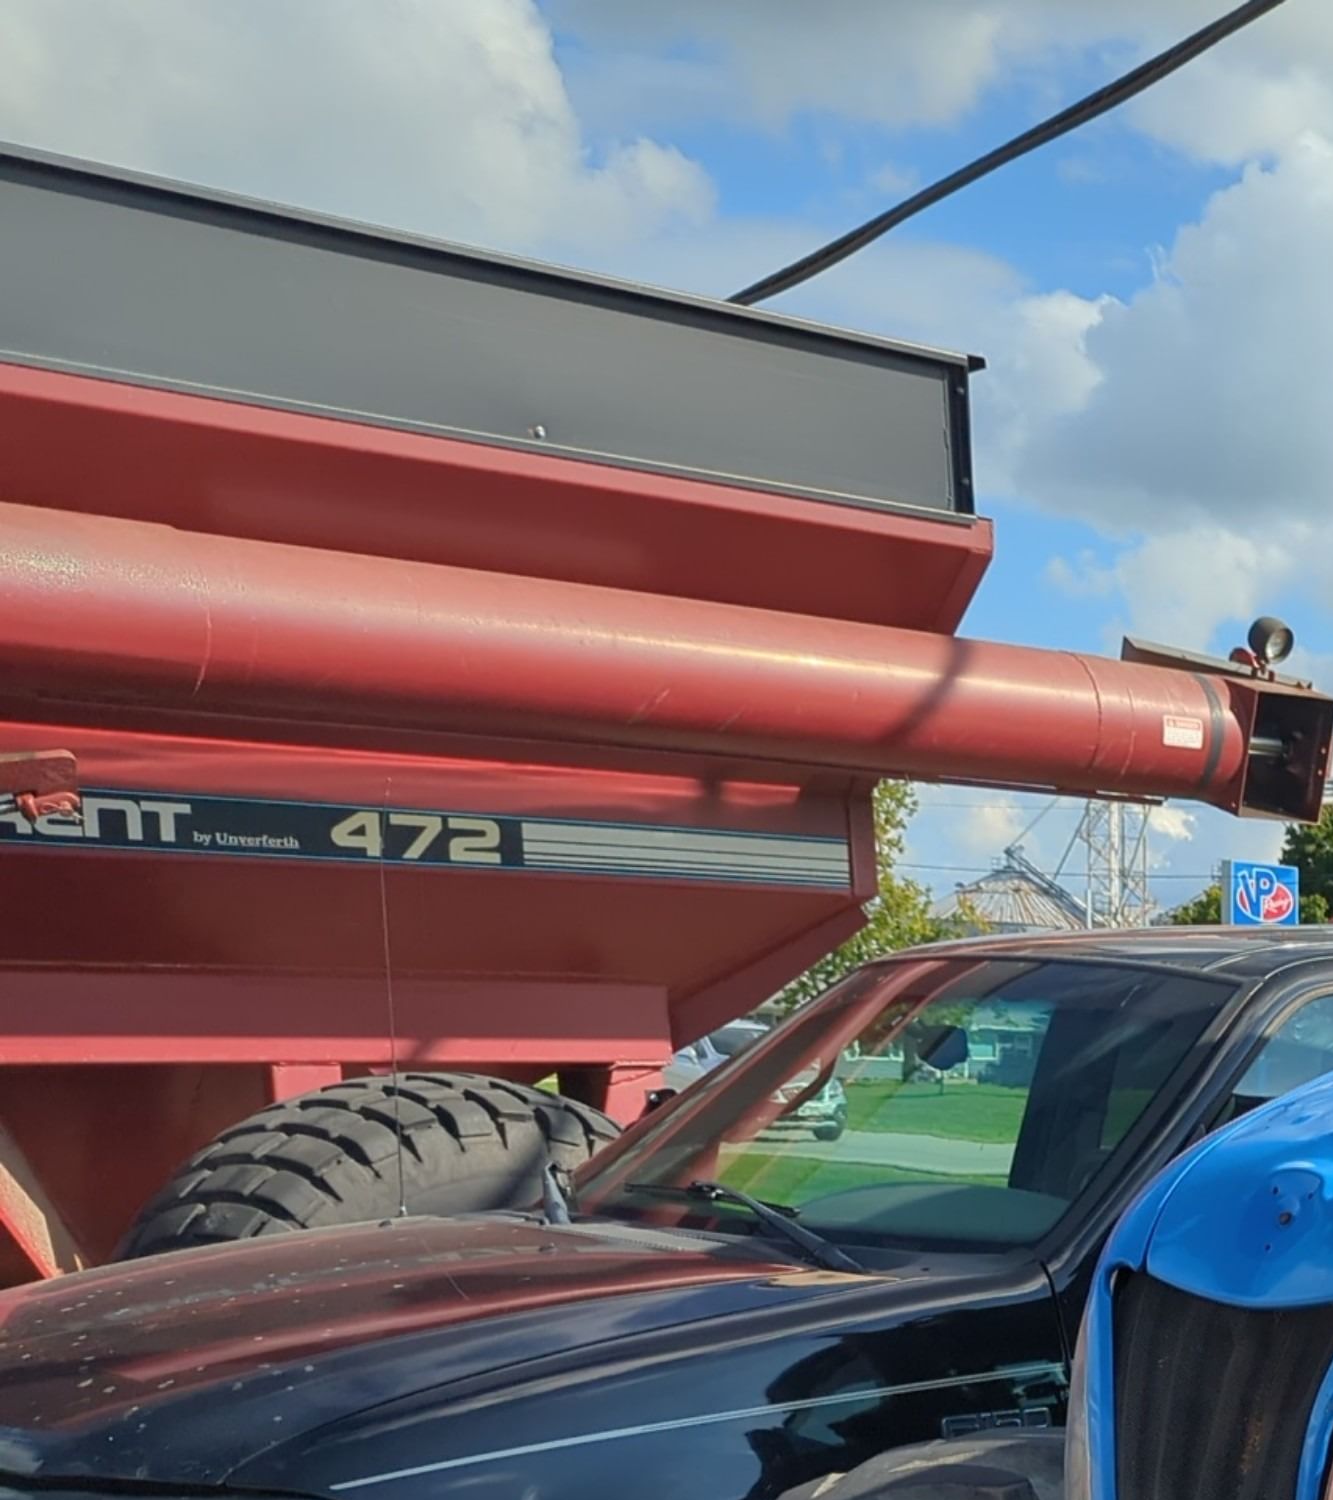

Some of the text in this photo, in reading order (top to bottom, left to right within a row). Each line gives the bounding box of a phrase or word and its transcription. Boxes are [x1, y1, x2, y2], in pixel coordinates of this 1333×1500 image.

[192, 830, 211, 847] by
[215, 831, 300, 849] Unverferth
[330, 811, 502, 864] 472
[1238, 867, 1277, 921] VP
